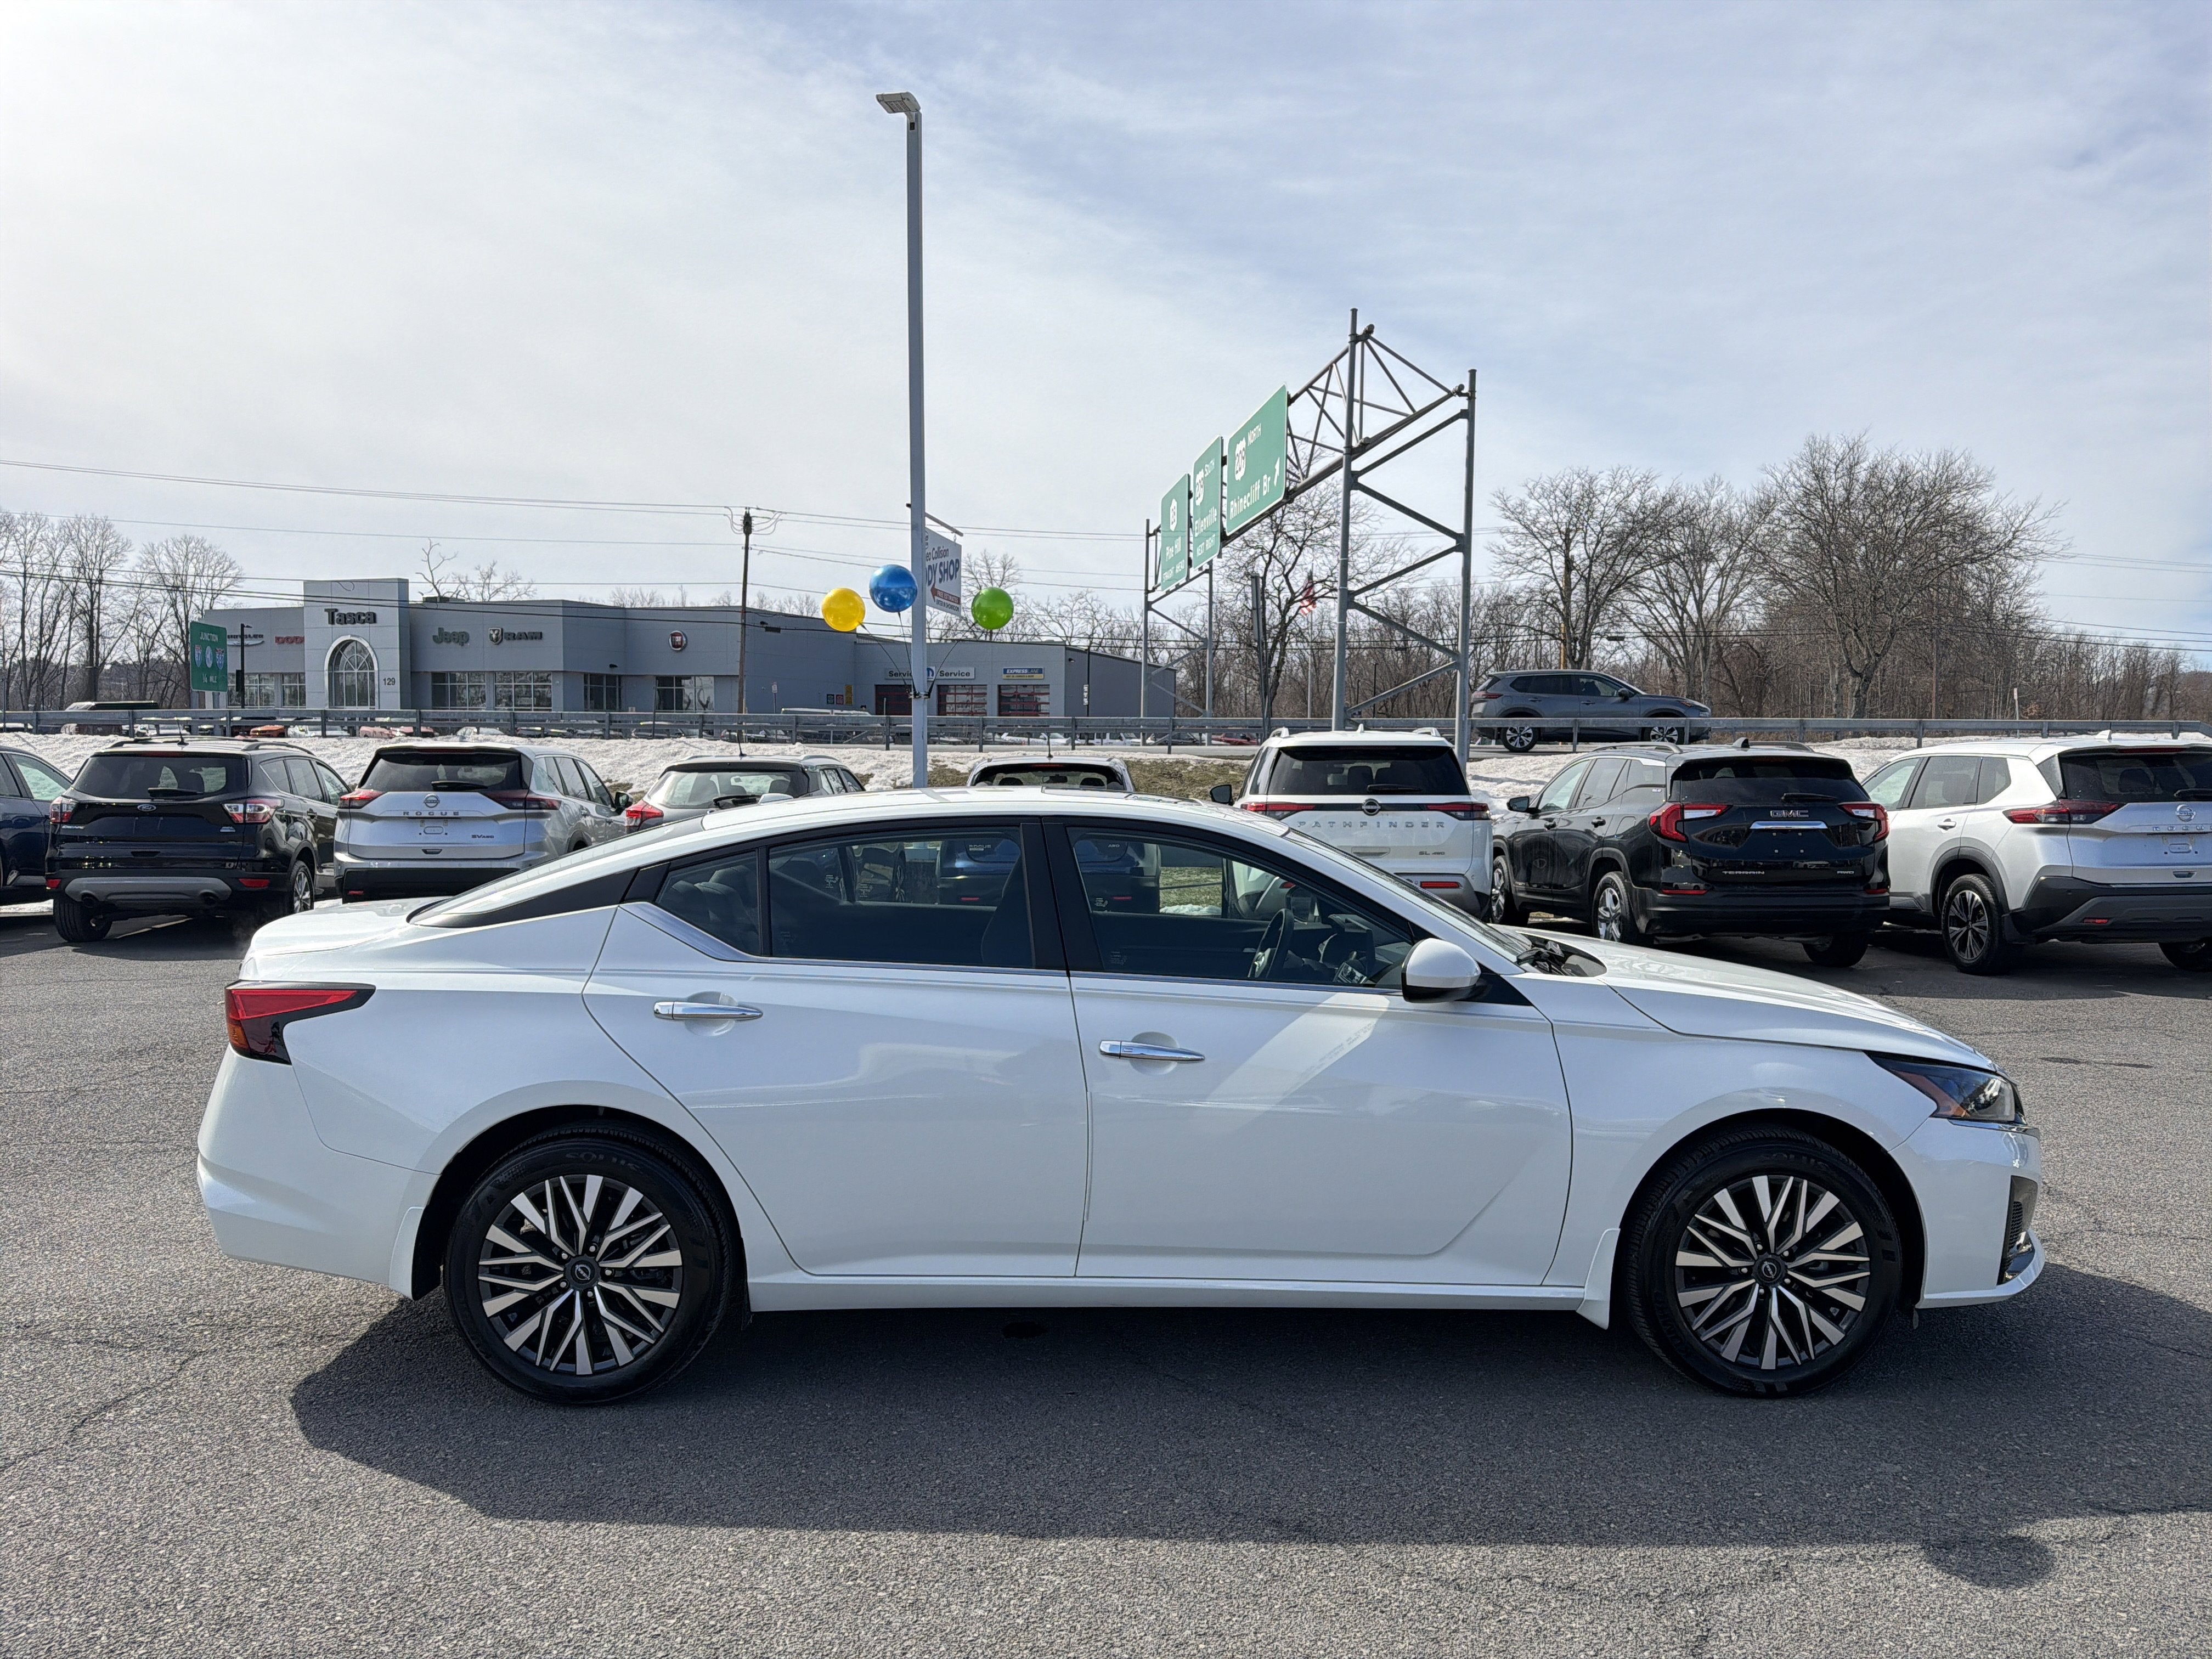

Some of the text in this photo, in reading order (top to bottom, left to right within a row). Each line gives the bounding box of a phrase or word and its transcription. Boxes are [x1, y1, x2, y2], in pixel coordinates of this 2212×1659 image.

[1248, 423, 1262, 446] NORTH
[1235, 447, 1245, 475] 209
[1229, 474, 1271, 520] Rhinecliff Br
[1194, 506, 1217, 538] Ellenville
[932, 546, 949, 560] Collision
[926, 558, 960, 587] DY SHOP
[944, 592, 958, 603] ESTIMATES
[324, 608, 377, 625] Tasca
[200, 631, 218, 642] JUNCTION
[432, 627, 470, 647] Jeep
[504, 631, 543, 641] RAM
[216, 653, 224, 664] 587
[383, 678, 396, 686] 129
